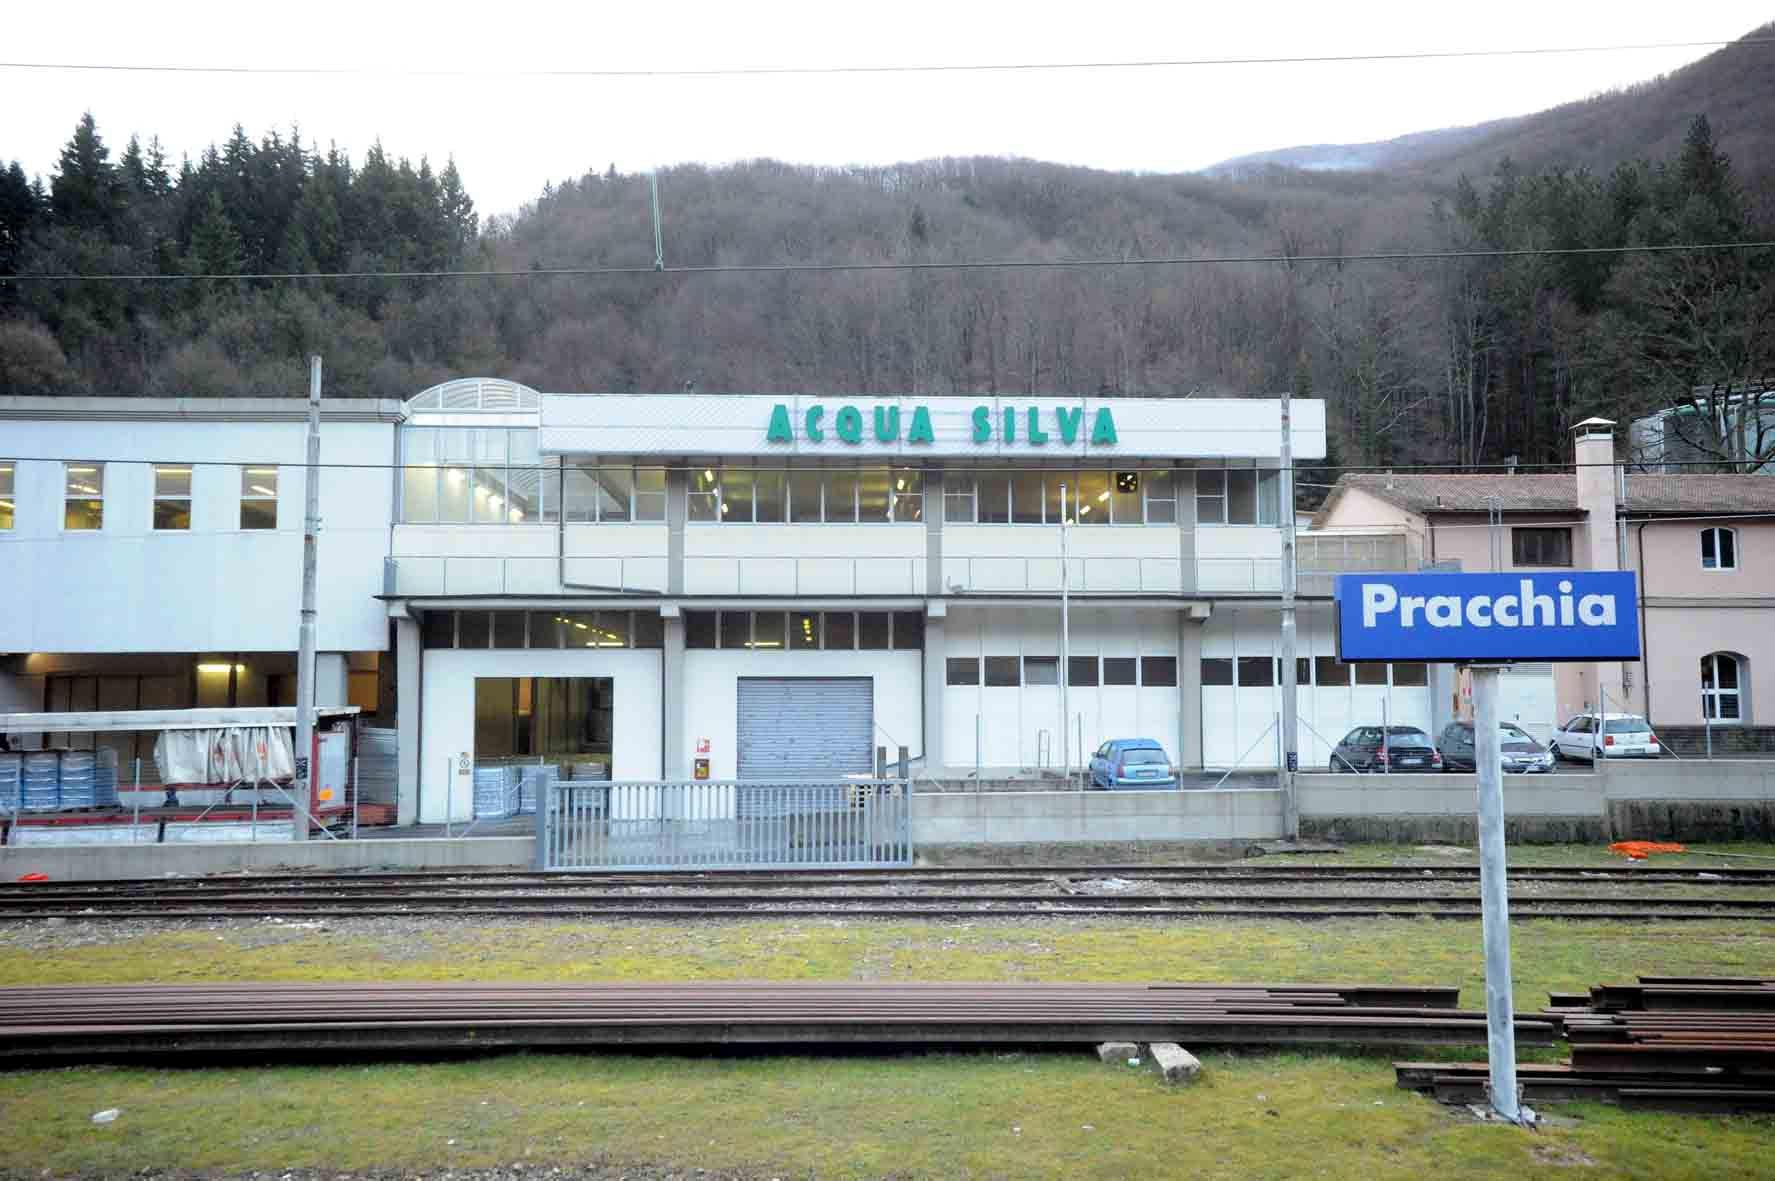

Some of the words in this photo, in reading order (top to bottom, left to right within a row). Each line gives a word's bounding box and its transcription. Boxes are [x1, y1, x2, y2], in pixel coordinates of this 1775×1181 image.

[767, 404, 935, 444] ACQUA
[972, 405, 1119, 444] SILVA
[1361, 578, 1618, 628] Pracchia
